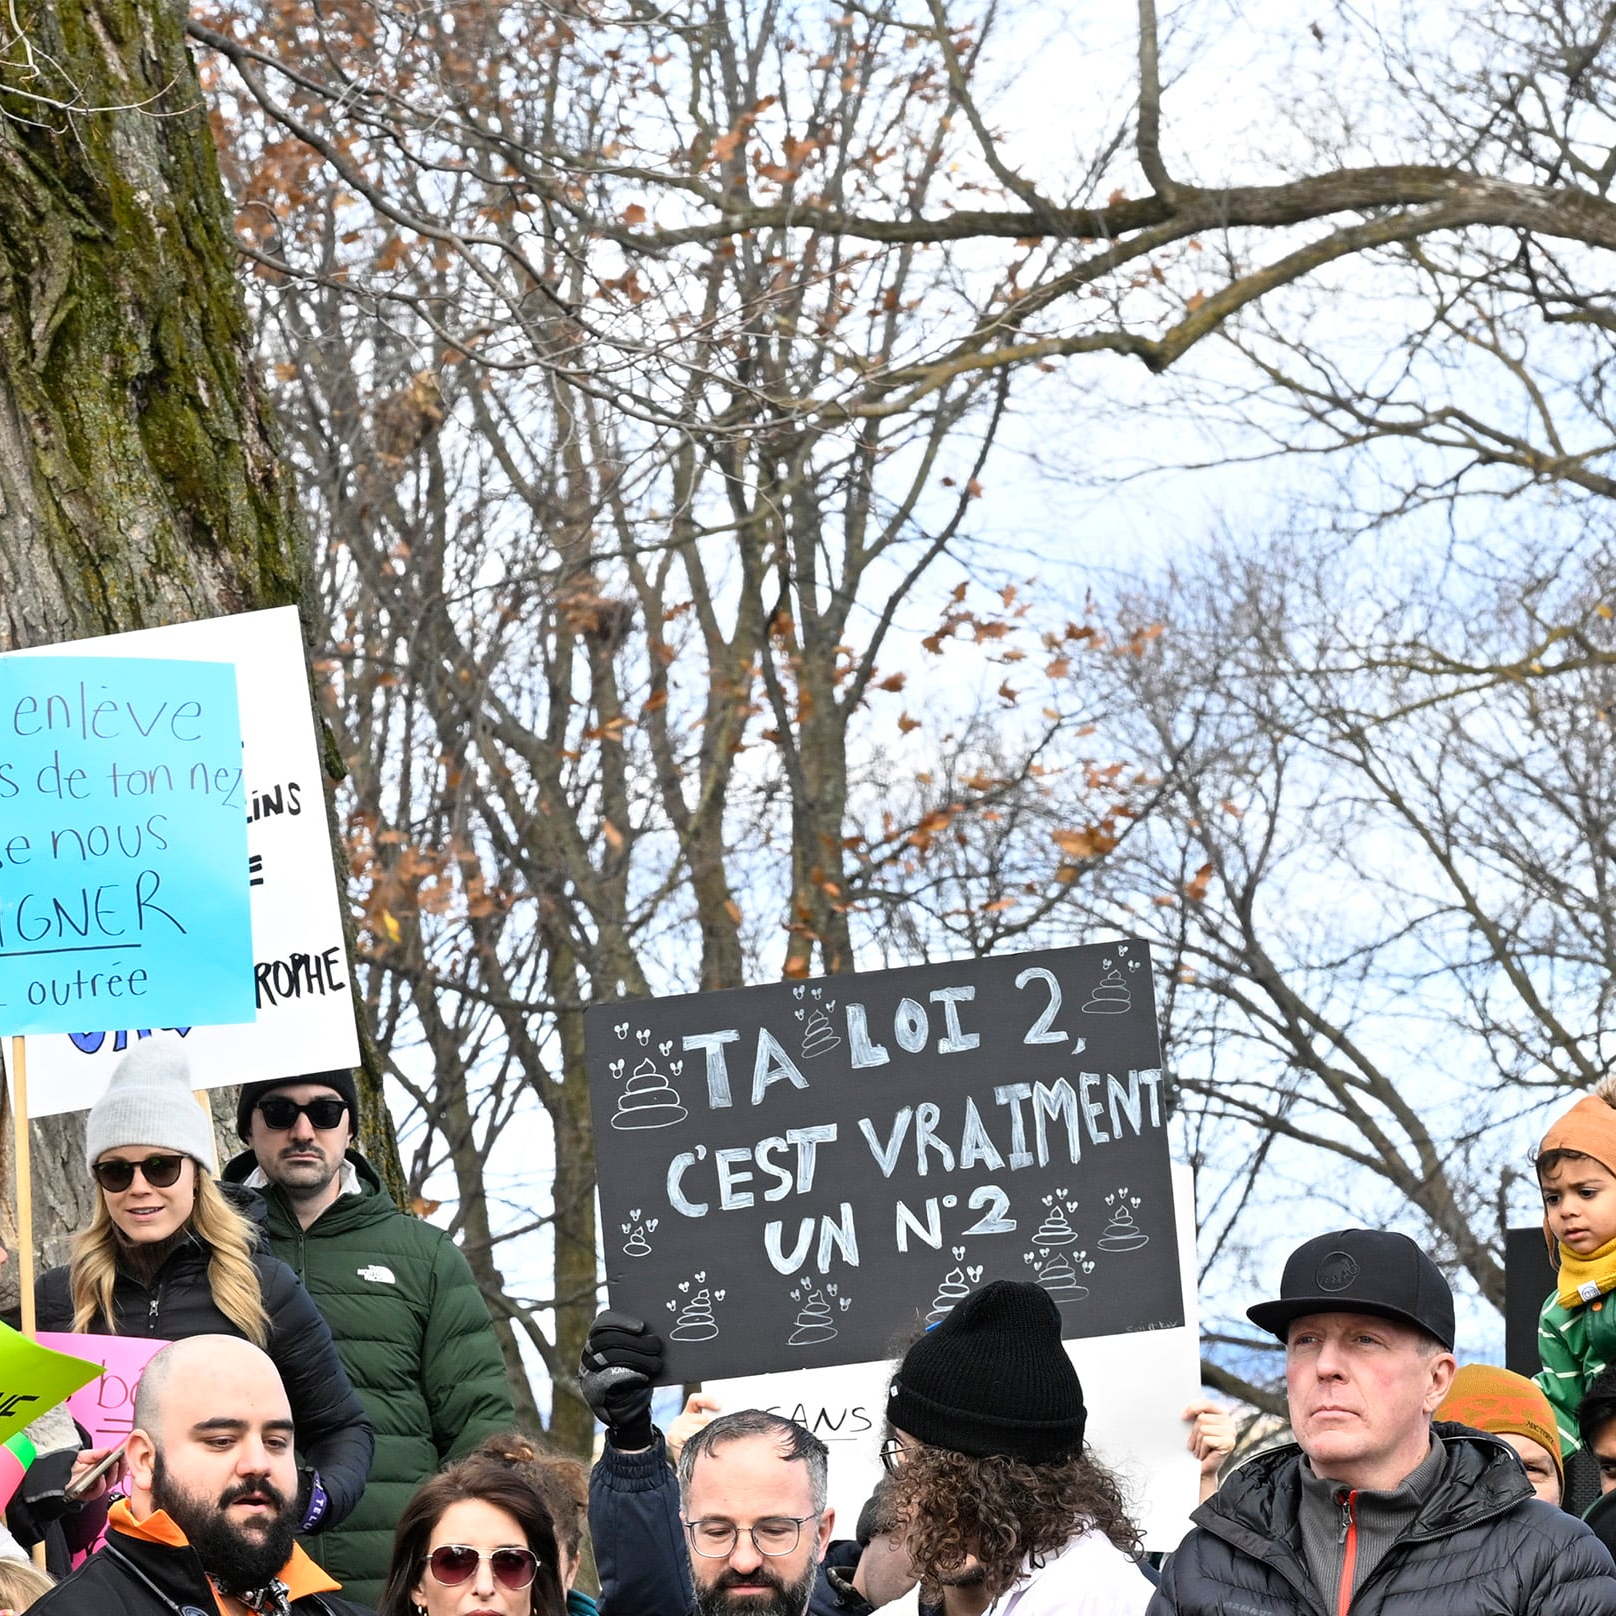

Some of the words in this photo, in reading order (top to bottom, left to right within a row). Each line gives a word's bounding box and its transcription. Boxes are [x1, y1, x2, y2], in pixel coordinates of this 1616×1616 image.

[13, 681, 203, 742] enlève
[35, 749, 88, 801] de
[111, 761, 176, 799] ton
[188, 760, 245, 808] nez
[50, 813, 169, 862] nous
[27, 960, 149, 1007] outrée
[253, 945, 346, 1010] ROPHE
[680, 1025, 811, 1110] TA
[845, 984, 982, 1070] LOI
[666, 1122, 839, 1218] C'EST
[857, 1066, 1163, 1178] VRAIMENT
[764, 1202, 861, 1276] UN
[765, 1402, 872, 1433] ANS
